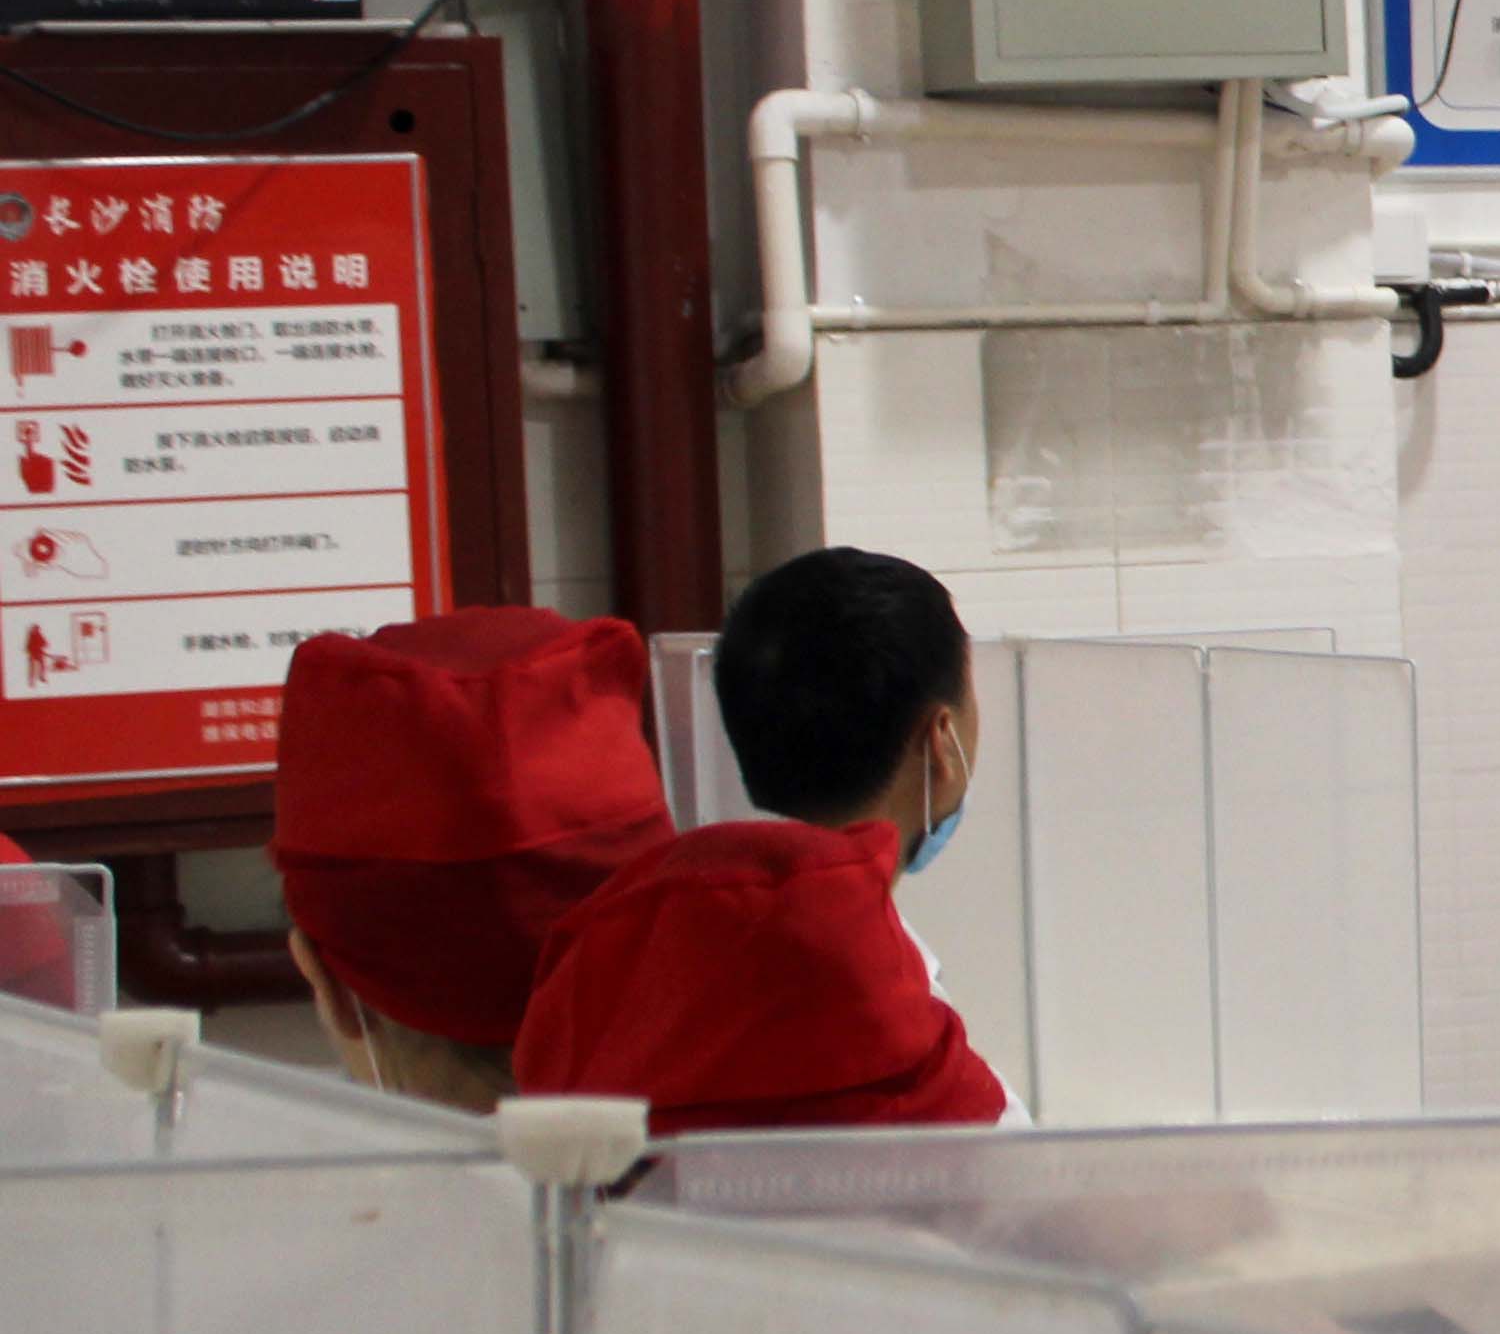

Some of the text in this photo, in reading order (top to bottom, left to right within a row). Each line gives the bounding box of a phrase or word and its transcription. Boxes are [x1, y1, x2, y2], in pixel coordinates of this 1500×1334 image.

[43, 192, 227, 237] 长沙消防
[9, 252, 370, 297] 消火栓使用说明
